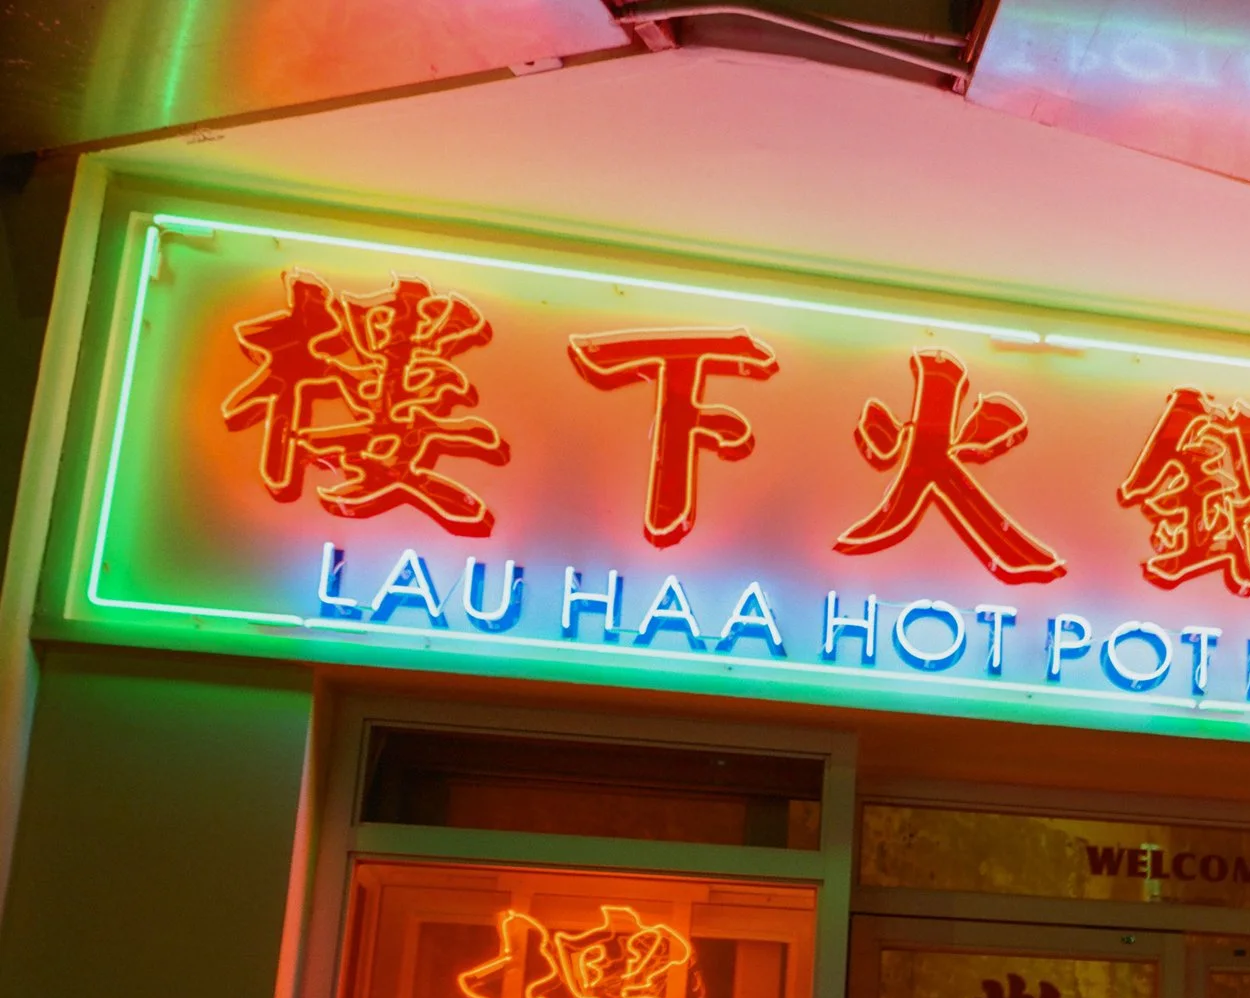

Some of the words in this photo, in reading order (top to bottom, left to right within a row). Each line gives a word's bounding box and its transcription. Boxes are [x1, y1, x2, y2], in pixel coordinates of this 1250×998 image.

[318, 541, 525, 632] LAU
[561, 565, 788, 658] HAA
[822, 588, 1018, 676] HOT
[1047, 612, 1222, 693] POT
